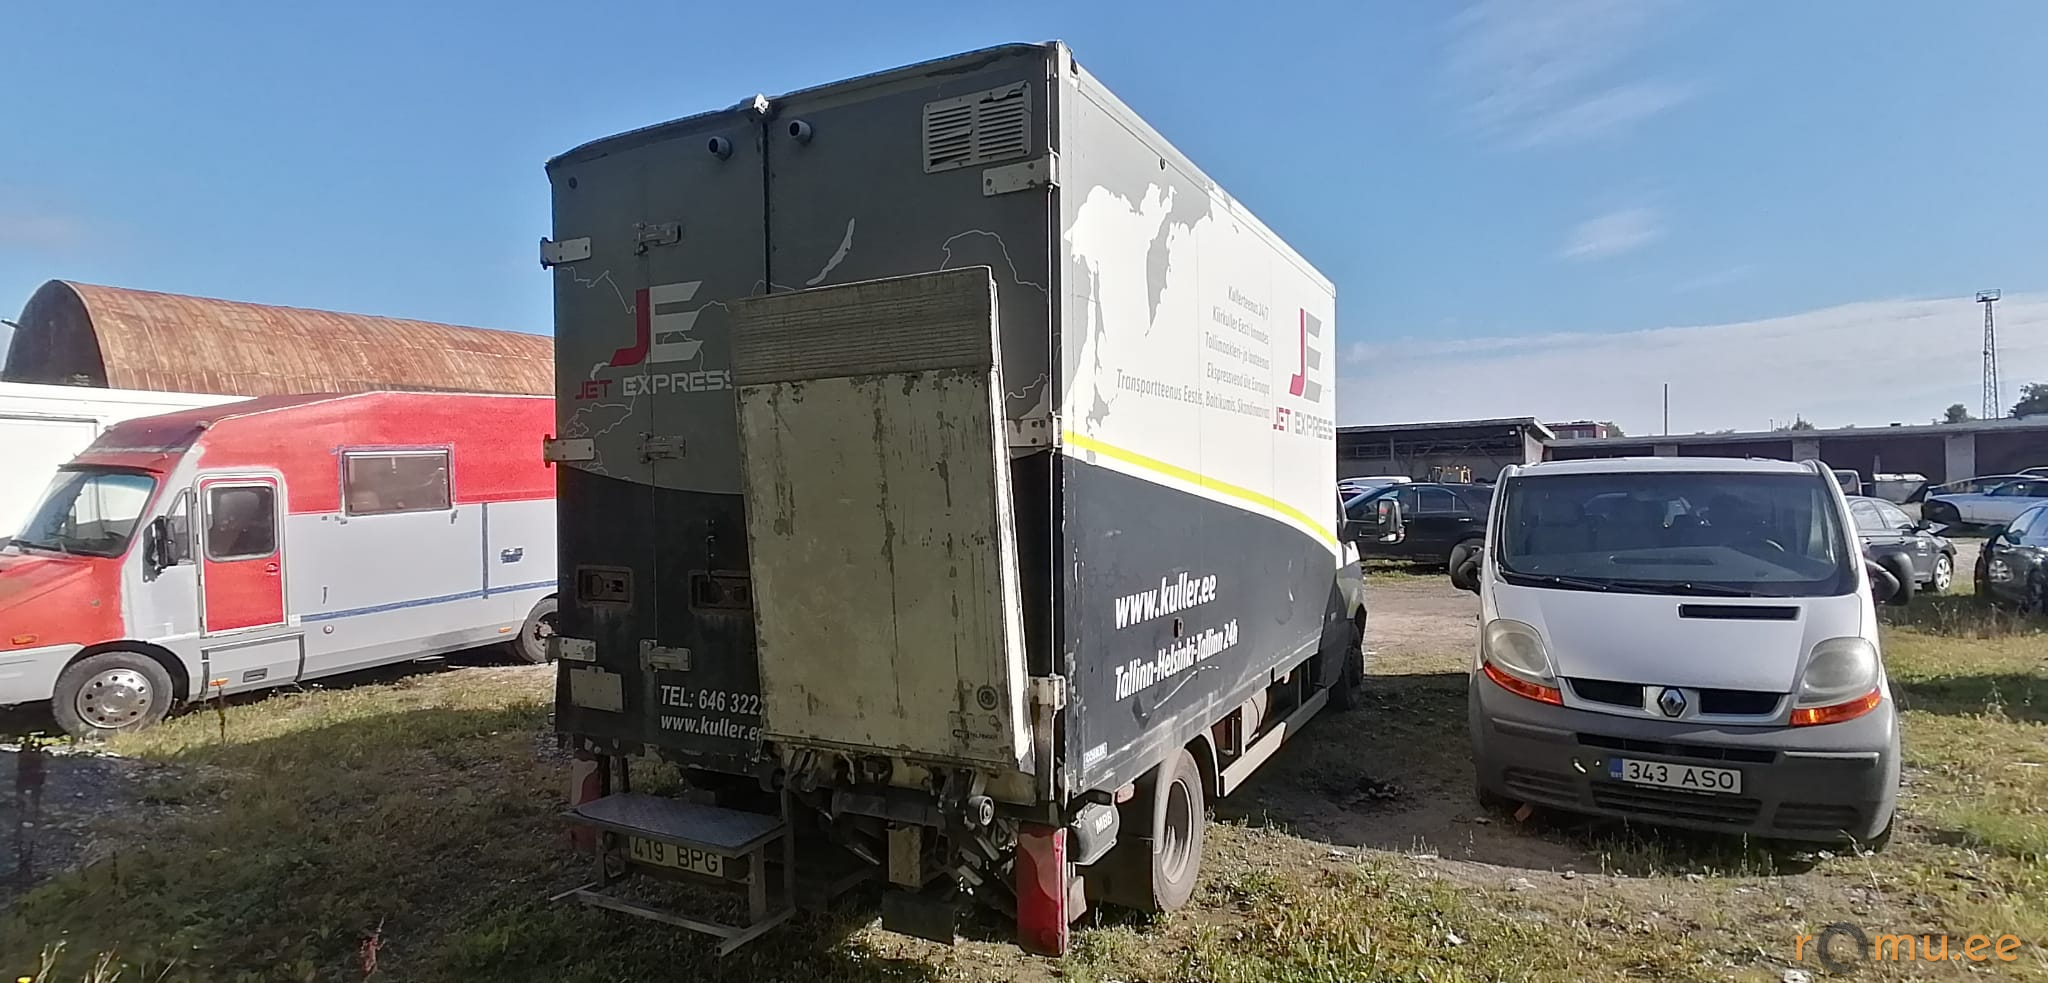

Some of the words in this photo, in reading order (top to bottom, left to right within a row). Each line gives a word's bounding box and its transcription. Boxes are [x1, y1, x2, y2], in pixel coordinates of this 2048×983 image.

[575, 379, 612, 400] JET
[1117, 368, 1182, 401] Transportteenus
[1184, 384, 1205, 408] Eestis,
[1273, 407, 1291, 432] JET
[1295, 411, 1333, 441] EXPRESS
[1115, 571, 1217, 630] www.kuller.ee
[1115, 627, 1224, 702] Tallinn-Helsinki-Tallinn
[1223, 618, 1239, 650] 24h
[661, 685, 694, 707] TEL:
[699, 689, 726, 711] 646
[730, 694, 763, 716] 322
[1629, 762, 1668, 783] 343
[1682, 768, 1734, 790] ASO
[1095, 810, 1113, 834] MBB
[634, 837, 664, 862] 419
[677, 847, 718, 873] BPG
